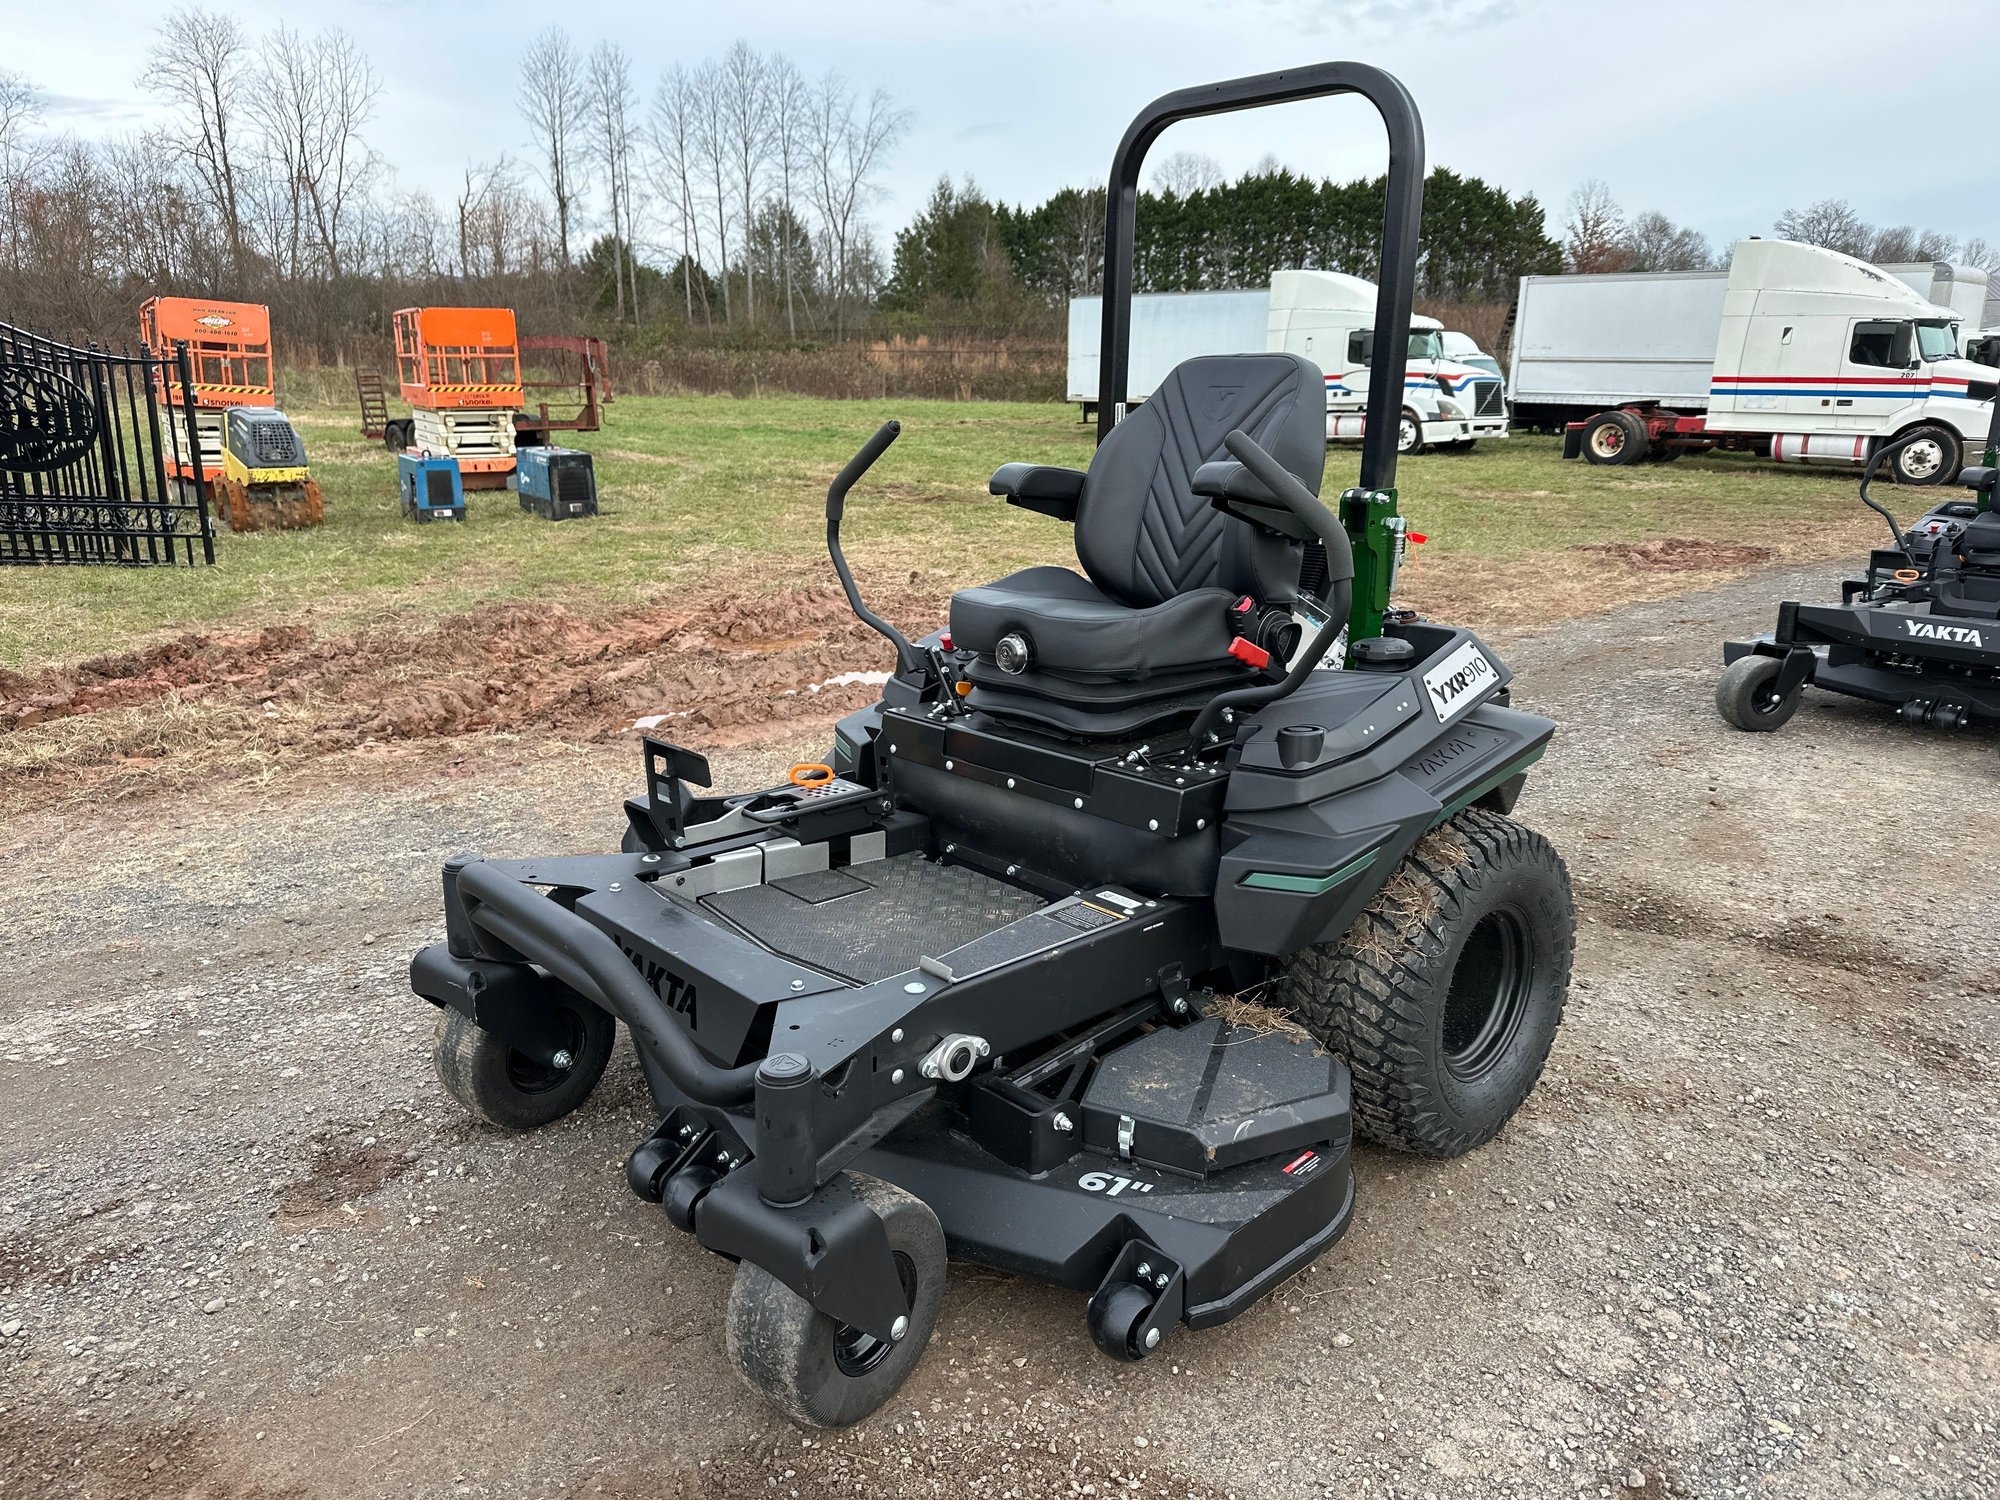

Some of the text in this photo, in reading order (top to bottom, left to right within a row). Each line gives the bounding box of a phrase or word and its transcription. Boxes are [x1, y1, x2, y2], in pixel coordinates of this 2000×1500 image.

[1905, 619, 1983, 648] YAKTA
[1431, 656, 1487, 705] YXR910
[1408, 738, 1477, 776] YAKTA
[1078, 1171, 1155, 1197] 61"
